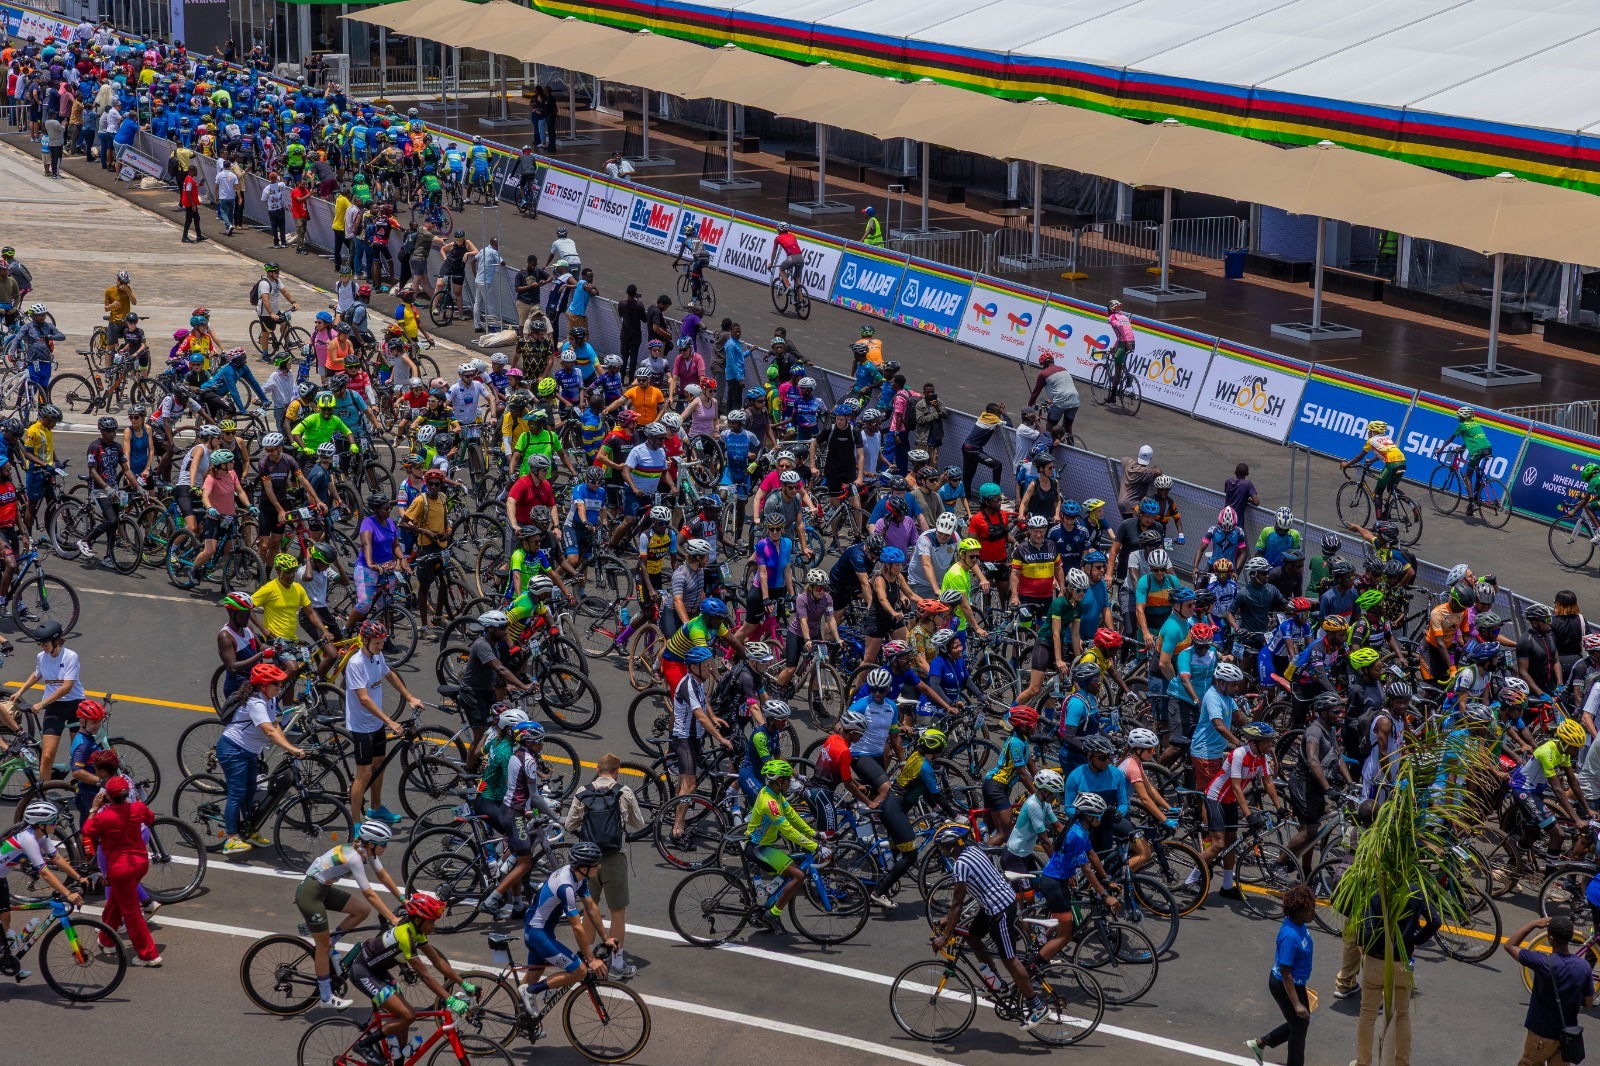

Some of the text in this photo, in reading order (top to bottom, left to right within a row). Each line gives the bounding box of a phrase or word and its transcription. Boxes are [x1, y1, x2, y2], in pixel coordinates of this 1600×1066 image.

[556, 185, 582, 203] TISSOT
[599, 198, 628, 218] TISSOT
[631, 198, 674, 232] BigMat
[627, 229, 640, 240] HOME
[739, 232, 767, 254] VISIT
[724, 248, 768, 275] RWANDA
[855, 268, 896, 297] MAPEI
[917, 286, 962, 317] MAPEI
[1128, 353, 1193, 390] WHOOSH
[1215, 380, 1286, 418] WHOOSH
[1300, 402, 1395, 441] SHIMA
[1542, 481, 1567, 497] MOVES,
[1552, 473, 1589, 491] WHEN AFR
